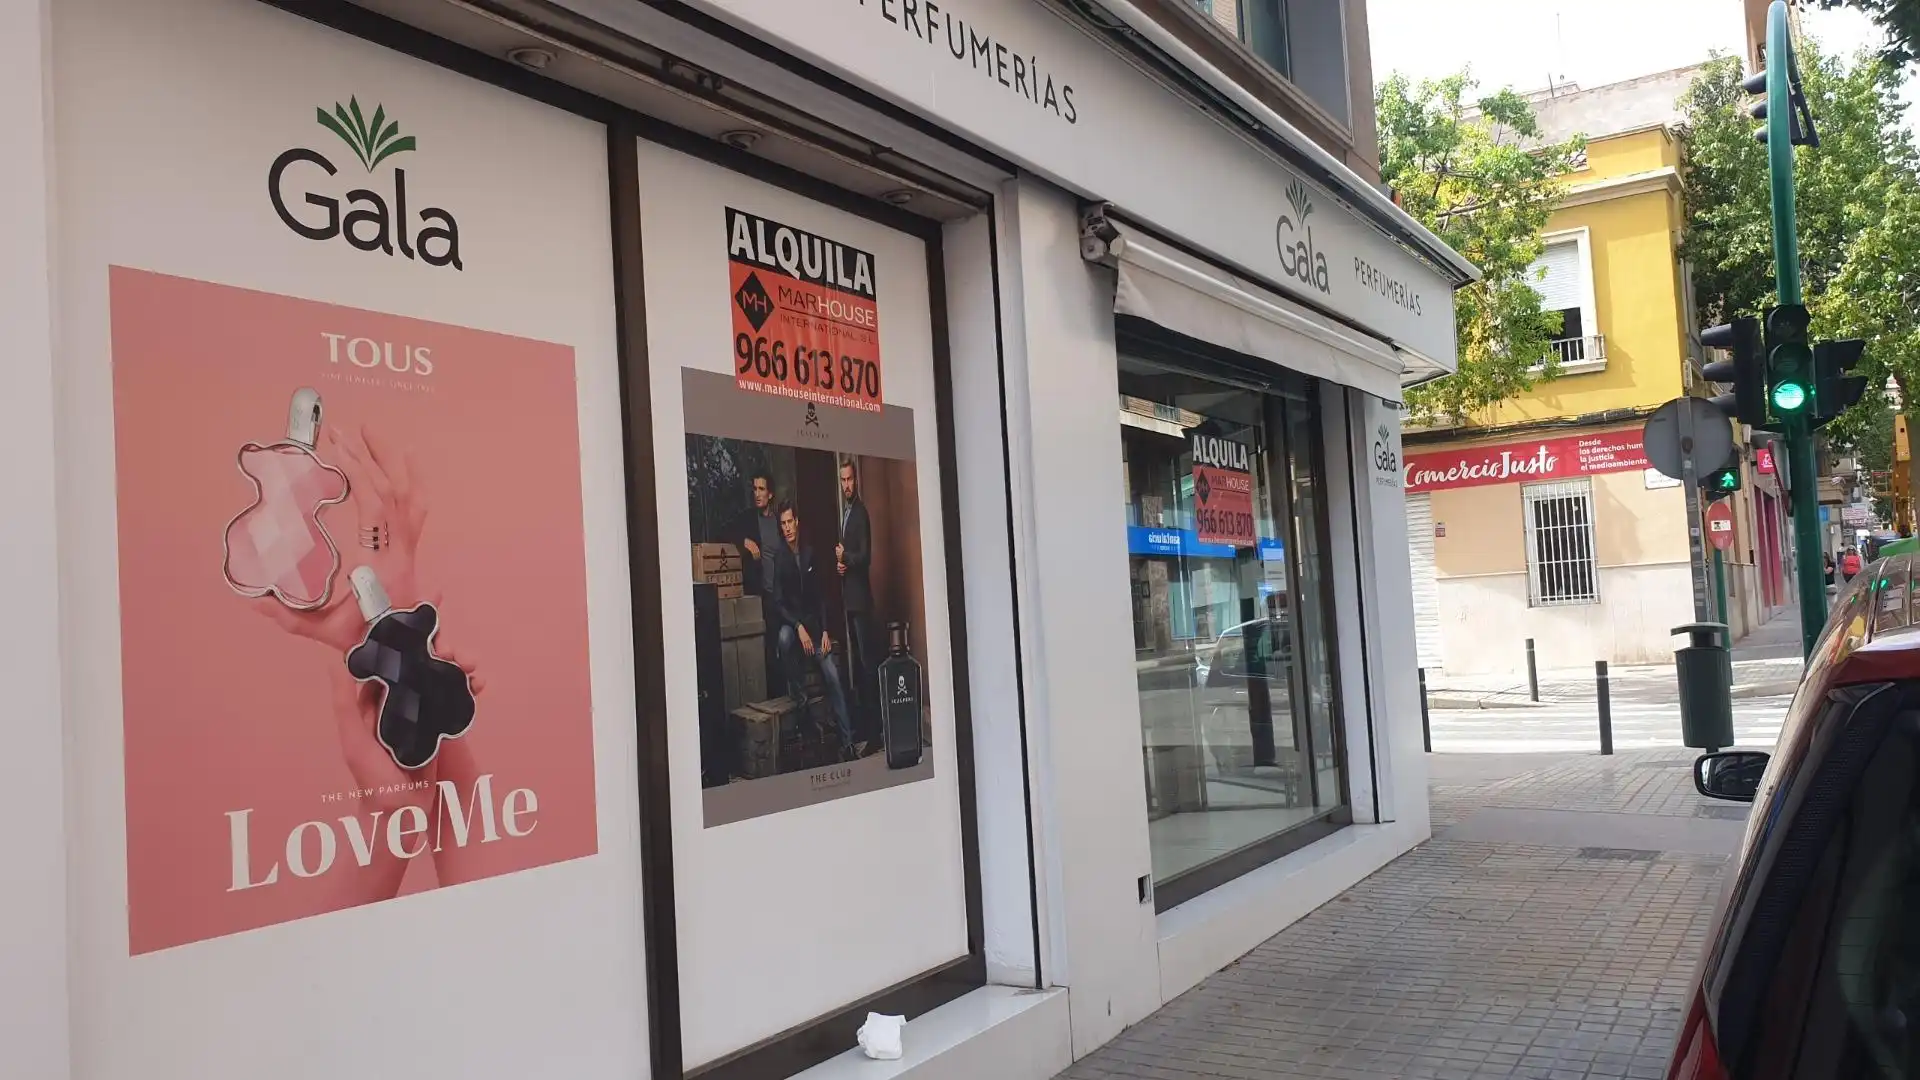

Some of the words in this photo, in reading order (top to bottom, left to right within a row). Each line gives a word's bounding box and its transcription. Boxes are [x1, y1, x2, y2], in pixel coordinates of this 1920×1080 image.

[859, 0, 1077, 124] ERFUMERÍAS
[268, 148, 463, 271] Gala
[730, 213, 874, 296] ALQUILA
[1276, 215, 1330, 295] Gala
[1354, 256, 1422, 317] PERFUMERÍAS
[778, 285, 876, 327] MARHOUSE
[320, 332, 433, 376] TOUS
[736, 333, 788, 381] 966
[794, 345, 834, 389] 613
[840, 355, 879, 398] 870
[738, 379, 881, 412] www.marhouseinternational.com
[1193, 435, 1249, 471] ALQUILA
[1374, 441, 1397, 473] Gala
[1579, 439, 1601, 447] Desde
[1588, 454, 1614, 463] justicia
[1591, 444, 1625, 454] derechos
[1589, 459, 1648, 470] medioambiente
[1197, 508, 1218, 534] 966
[1219, 510, 1235, 536] 613
[1236, 512, 1255, 538] 870
[321, 792, 343, 803] THE
[349, 788, 374, 799] NEW
[379, 780, 429, 795] PARFUMS
[811, 774, 827, 783] THE
[830, 769, 852, 780] CLUB
